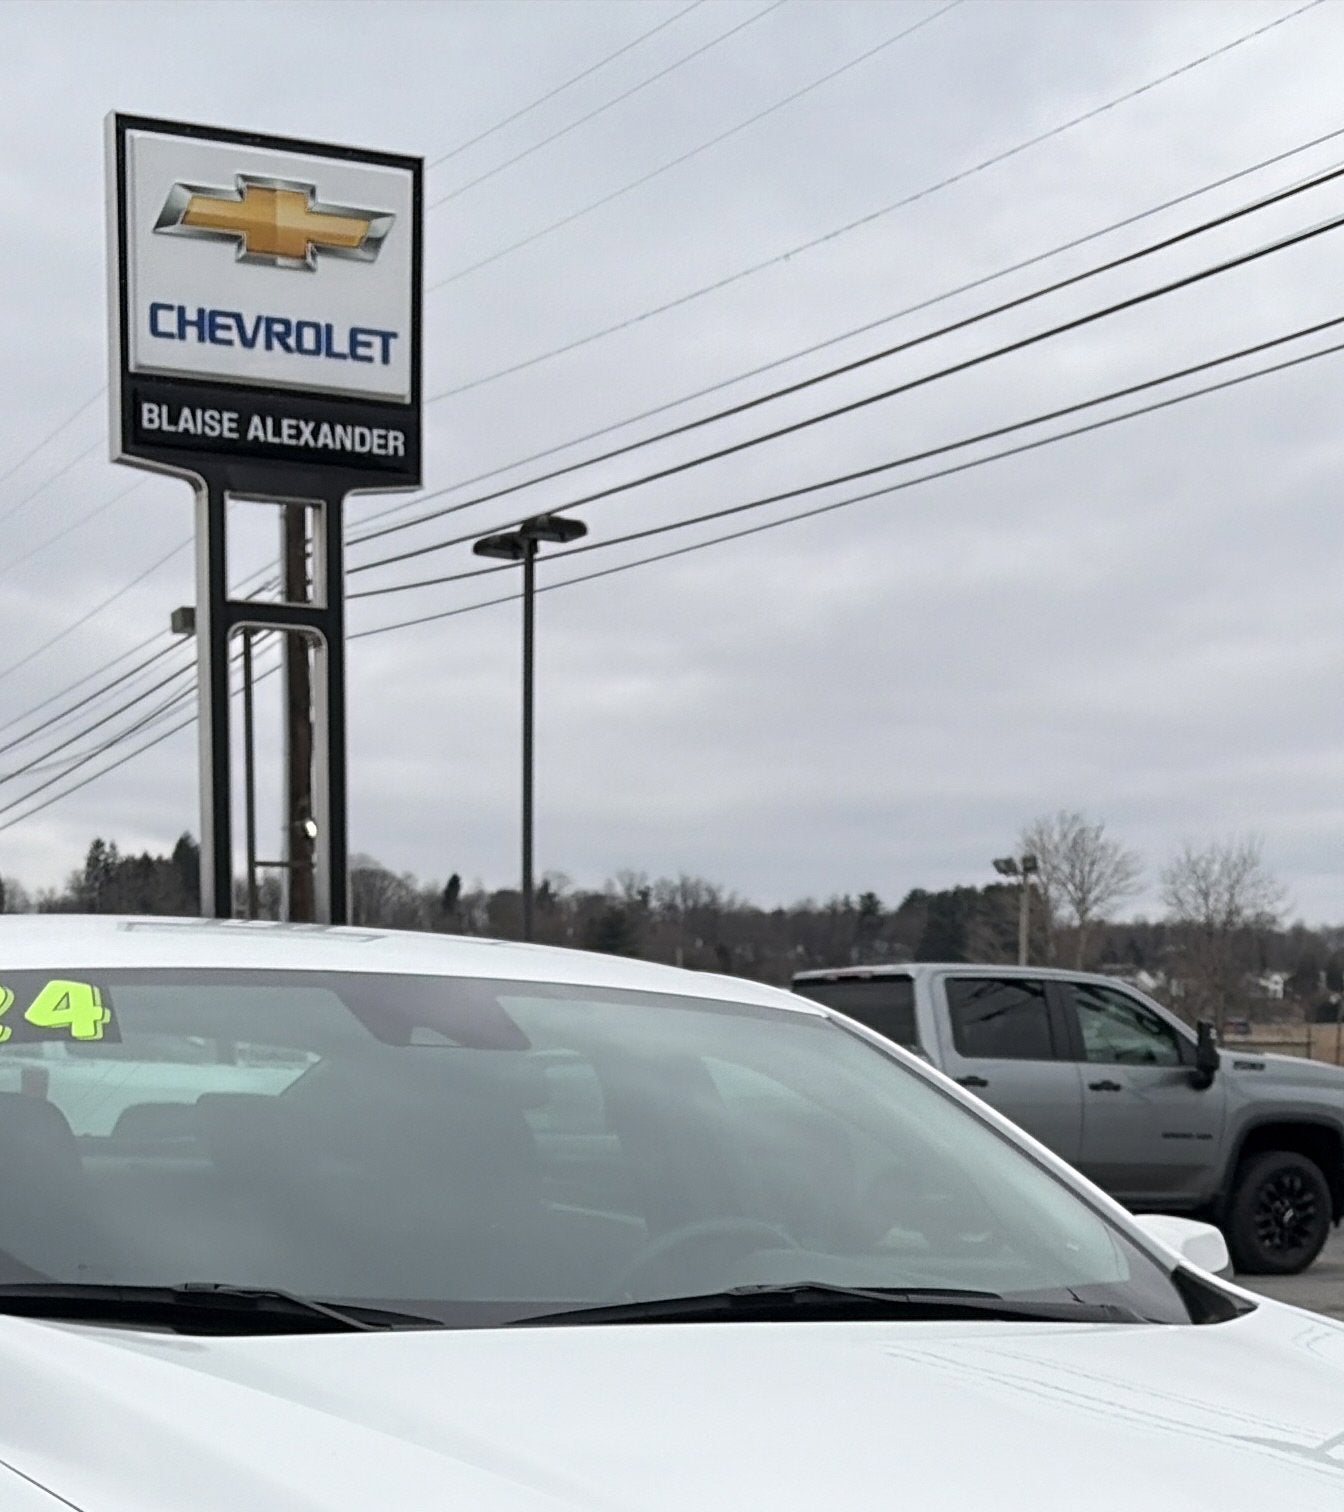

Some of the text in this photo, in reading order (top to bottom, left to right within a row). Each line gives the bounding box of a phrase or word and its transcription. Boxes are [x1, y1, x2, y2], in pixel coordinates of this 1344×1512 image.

[149, 302, 399, 366] CHEVROLET
[141, 402, 406, 457] BLAISE ALEXANDER
